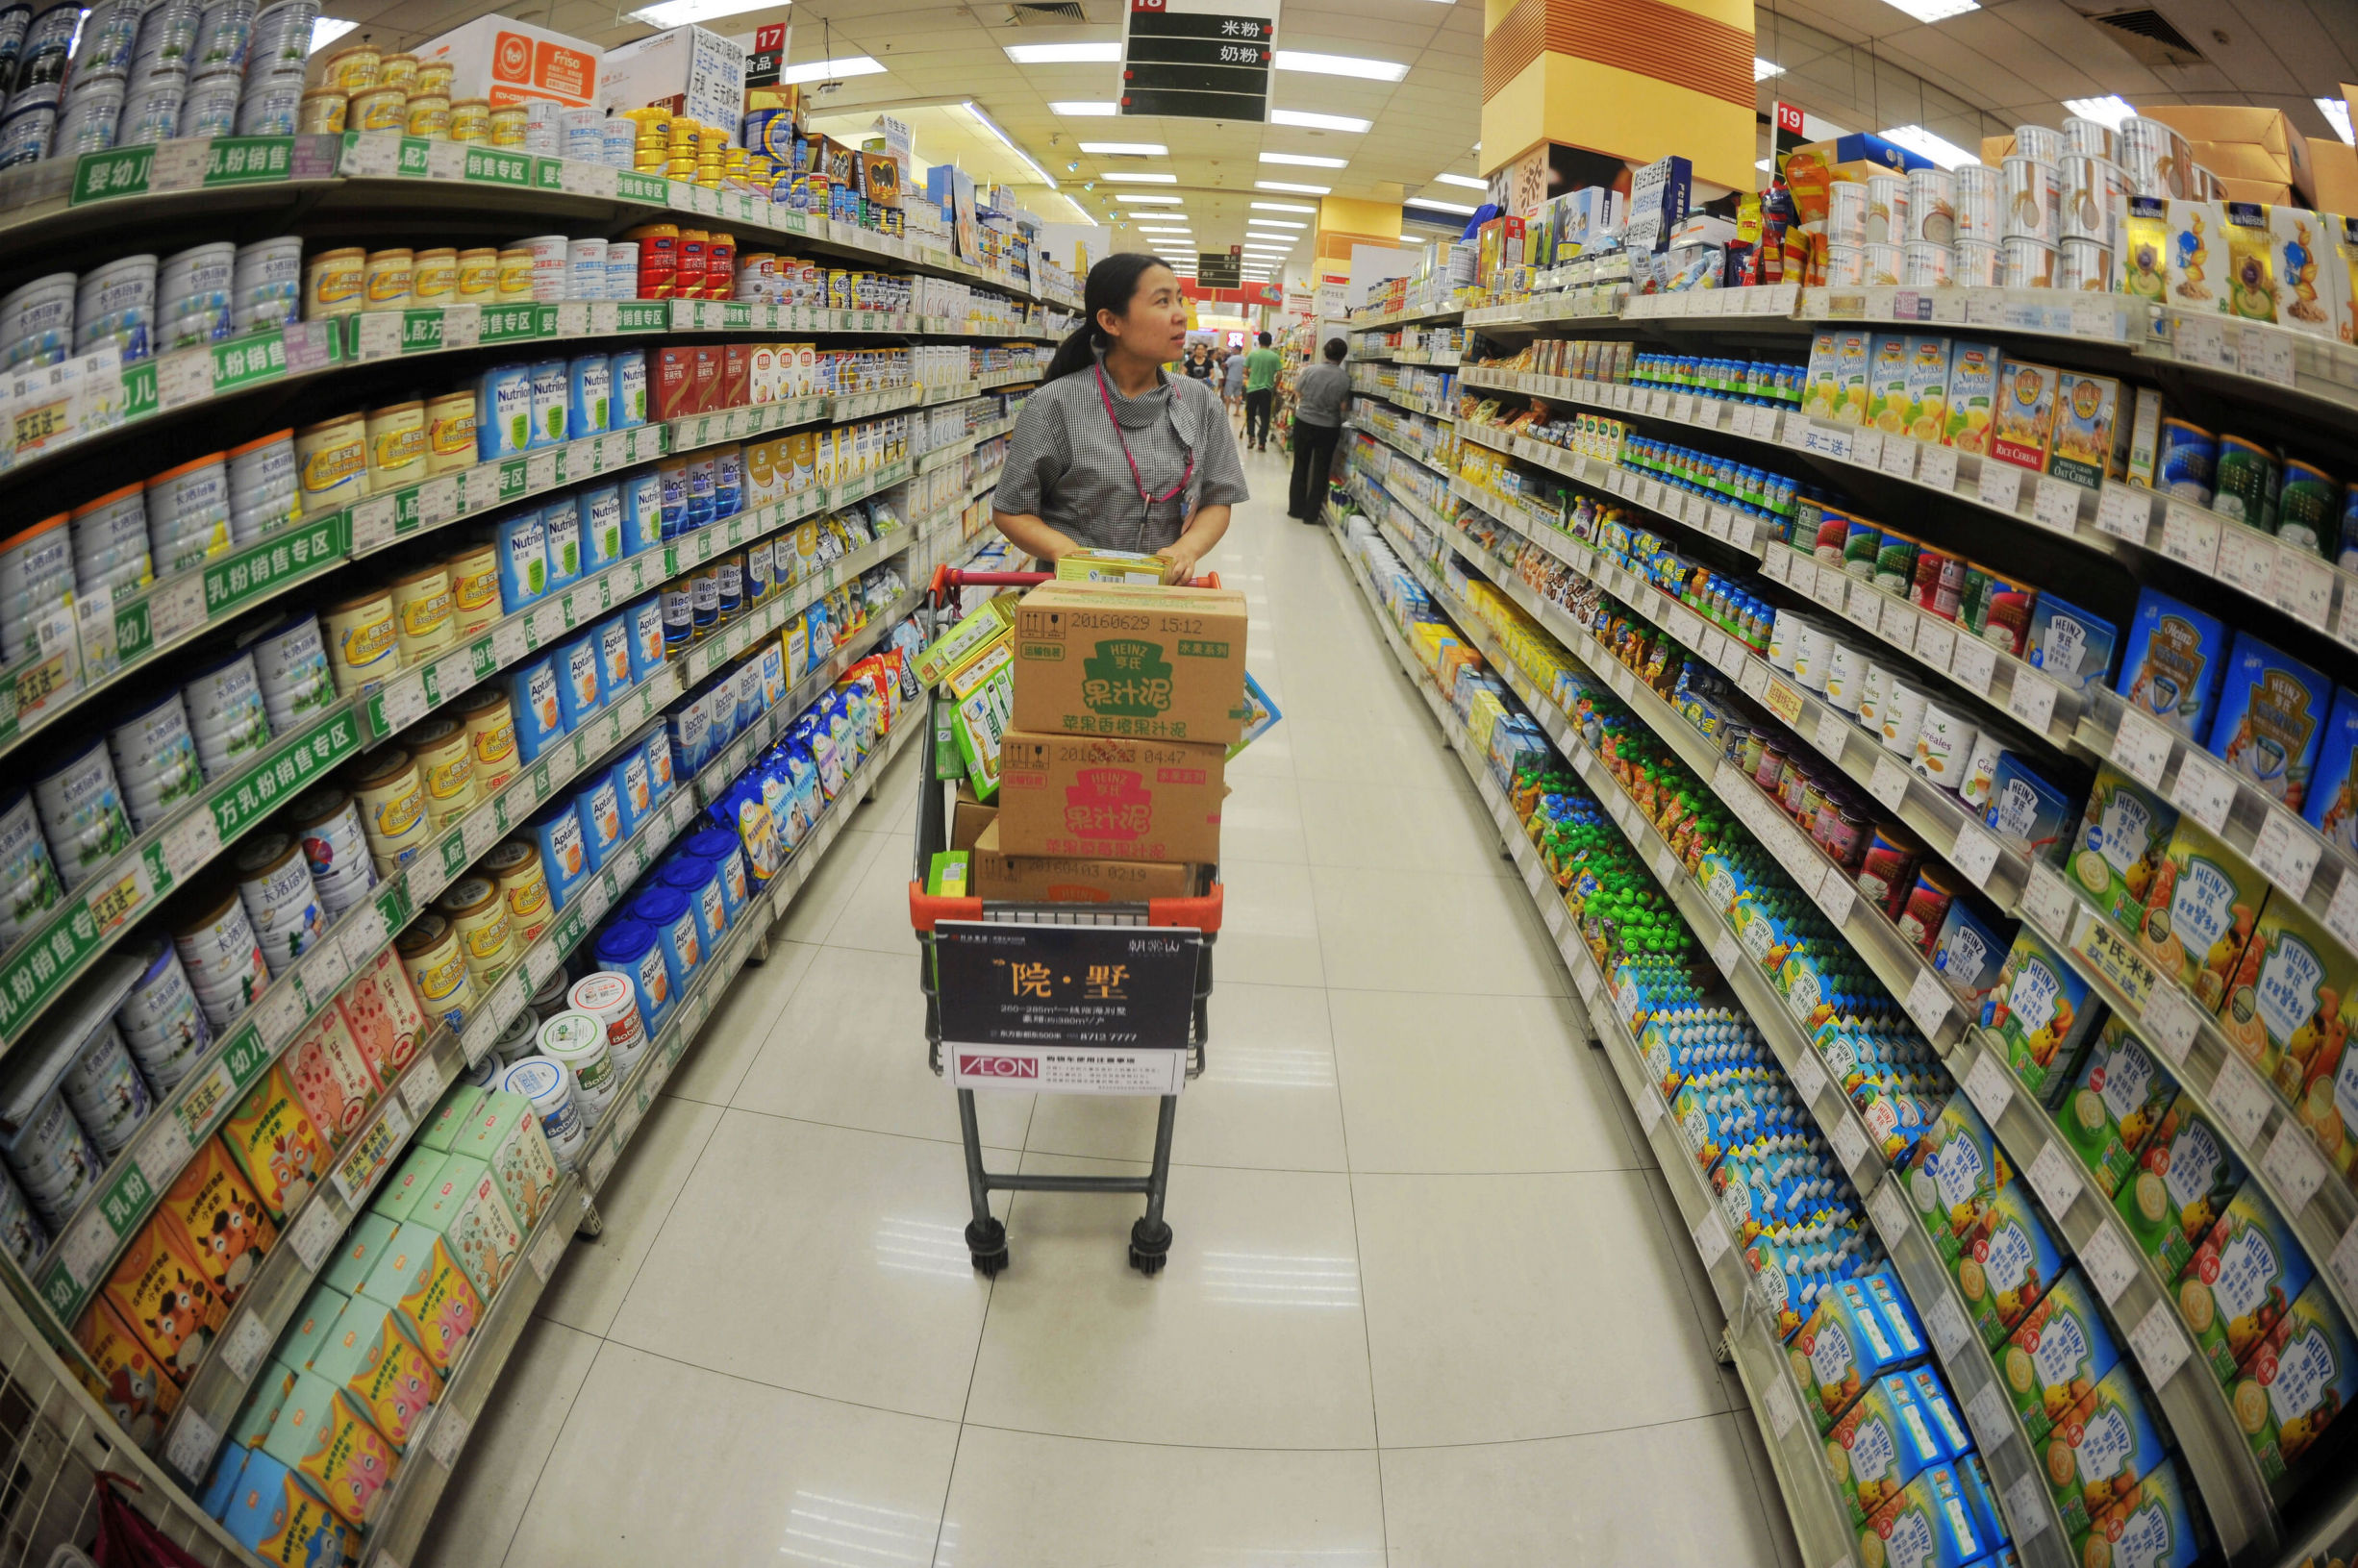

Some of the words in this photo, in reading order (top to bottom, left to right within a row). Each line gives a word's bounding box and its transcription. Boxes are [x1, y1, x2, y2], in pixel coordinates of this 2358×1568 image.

[759, 30, 781, 47] 17
[1220, 20, 1260, 37] 米粉
[554, 48, 581, 69] Friso
[1219, 46, 1259, 63] 奶粉
[1778, 107, 1802, 128] 19
[204, 144, 288, 175] 乳粉销售
[468, 155, 524, 181] 销售专区
[14, 407, 66, 445] 买五送一
[1806, 432, 1852, 457] 买二送一
[1996, 443, 2012, 457] RICE
[2013, 448, 2039, 464] CEREAL
[2069, 469, 2095, 486] CEREAL
[208, 529, 331, 605] 乳粉销售专区
[1070, 612, 1150, 632] 20160629
[1160, 616, 1202, 635] 15:12
[2055, 618, 2082, 639] HEINZ
[1023, 645, 1061, 658] 运输包装
[1111, 644, 1148, 658] HEINZ
[1180, 643, 1228, 656] 水果系列
[15, 661, 63, 709] 买五送一
[1084, 678, 1171, 710] 果汁泥
[2271, 678, 2302, 703] HEINZ
[1063, 714, 1187, 738] 苹果香橙果汁泥
[1144, 750, 1187, 763] 04:47
[220, 720, 351, 831] 方乳粉销售专区
[1091, 772, 1129, 786] HEINZ
[2011, 782, 2036, 807] HEINZ
[1068, 805, 1150, 834] 果汁泥
[2117, 796, 2148, 825] HEINZ
[2195, 868, 2228, 901] HEINZ
[93, 884, 136, 931] 买五送一
[1754, 920, 1770, 938] HEINZ
[1961, 929, 1984, 956] HEINZ
[2085, 942, 2146, 1004] 买三送一
[2284, 943, 2317, 981] HEINZ
[1803, 976, 1817, 994] HEINZ
[2030, 962, 2058, 996] HEINZ
[1837, 1044, 1852, 1061] HEINZ
[2123, 1042, 2152, 1077] HEINZ
[186, 1082, 221, 1123] 买五送一
[1878, 1107, 1894, 1125] HEINZ
[1693, 1113, 1705, 1132] HEINZ
[1958, 1137, 1981, 1173] HEINZ
[2191, 1124, 2219, 1165] HEINZ
[107, 1171, 146, 1224] 乳粉
[1735, 1185, 1747, 1206] HEINZ
[2008, 1227, 2031, 1262] HEINZ
[2245, 1233, 2274, 1276] HEINZ
[1769, 1272, 1784, 1295] HEINZ
[1830, 1327, 1850, 1359] HEINZ
[2062, 1319, 2085, 1356] HEINZ
[2305, 1335, 2332, 1380] HEINZ
[1873, 1421, 1893, 1458] HEINZ
[2106, 1412, 2129, 1453] HEINZ
[1913, 1515, 1931, 1554] HEINZ
[2147, 1510, 2168, 1552] HEINZ
